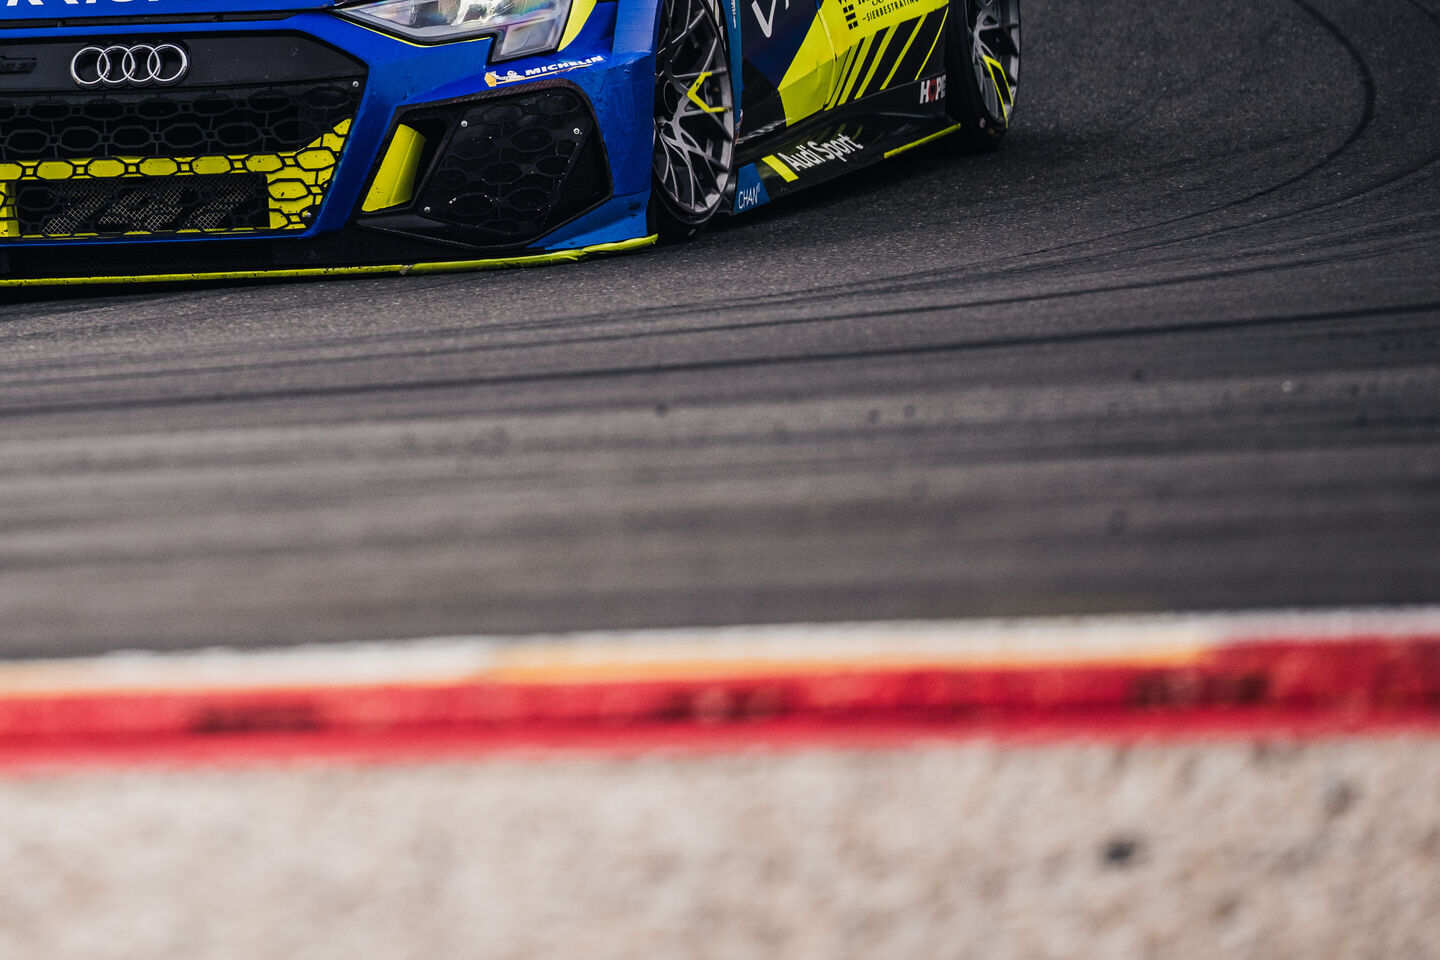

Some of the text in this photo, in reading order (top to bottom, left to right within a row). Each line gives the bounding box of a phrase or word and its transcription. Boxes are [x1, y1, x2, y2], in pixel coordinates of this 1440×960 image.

[525, 55, 604, 76] MICHELIN
[777, 133, 864, 172] Audi Sport
